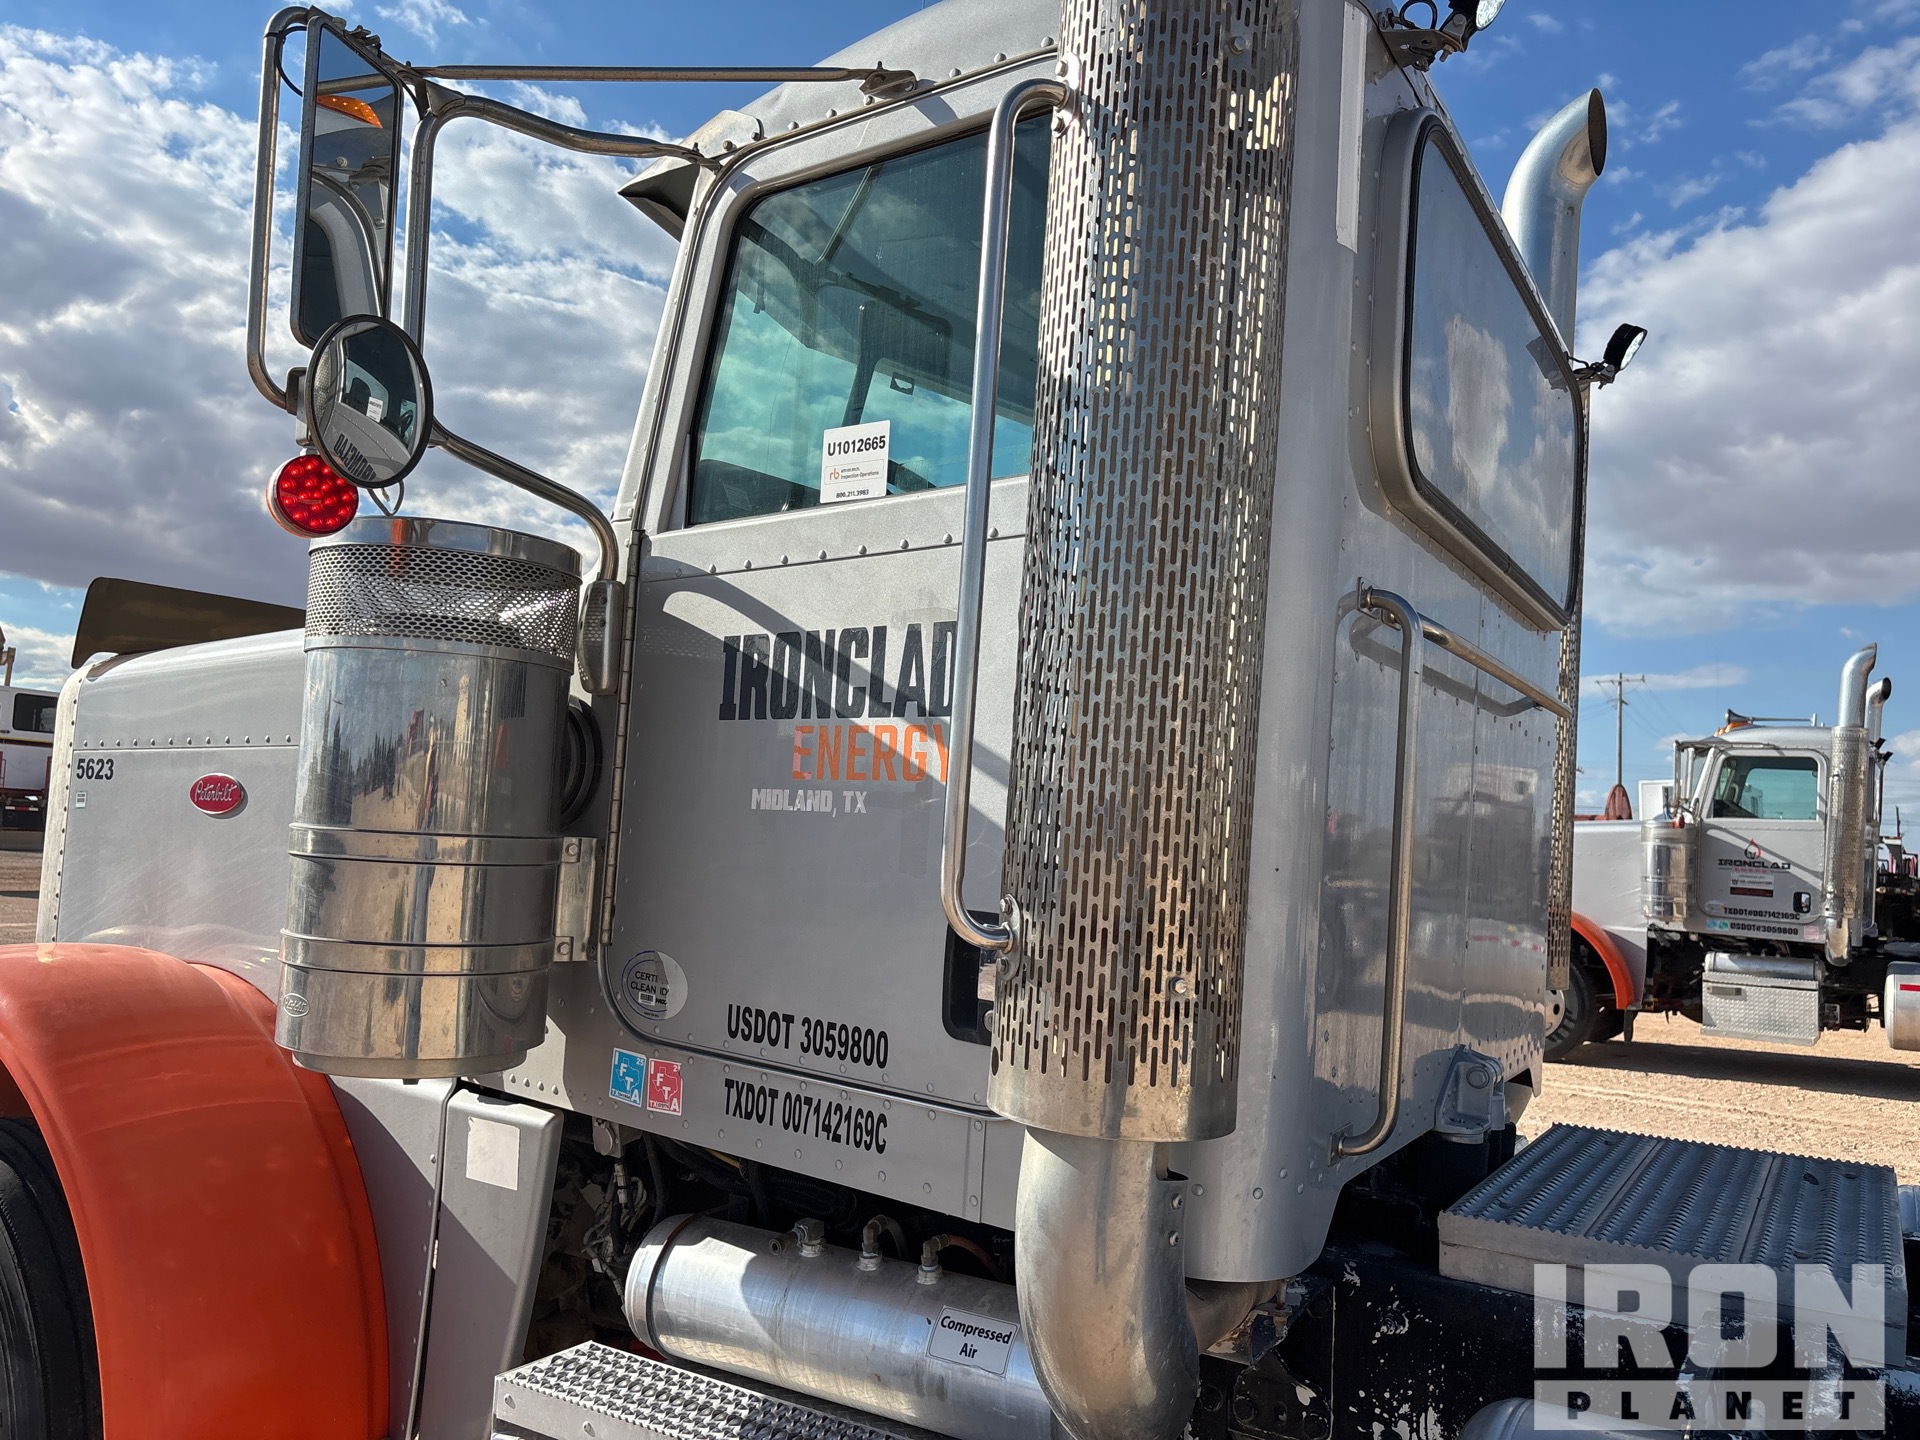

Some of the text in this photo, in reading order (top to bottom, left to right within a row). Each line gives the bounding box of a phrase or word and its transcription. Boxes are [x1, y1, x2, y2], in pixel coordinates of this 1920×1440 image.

[827, 435, 886, 456] U1012665
[719, 620, 958, 720] IRONCLAD
[792, 724, 950, 782] ENERGY
[76, 758, 114, 780] 5623
[194, 780, 238, 802] Peterbilt
[751, 788, 868, 817] MIDLAND, TX
[1718, 859, 1791, 870] IRONCLAD
[630, 981, 657, 994] CLEAN
[727, 1004, 889, 1069] USDOT 3059800
[724, 1078, 888, 1154] TXDOT 007142169C
[940, 1315, 1013, 1344] Compressed
[959, 1342, 978, 1359] Air
